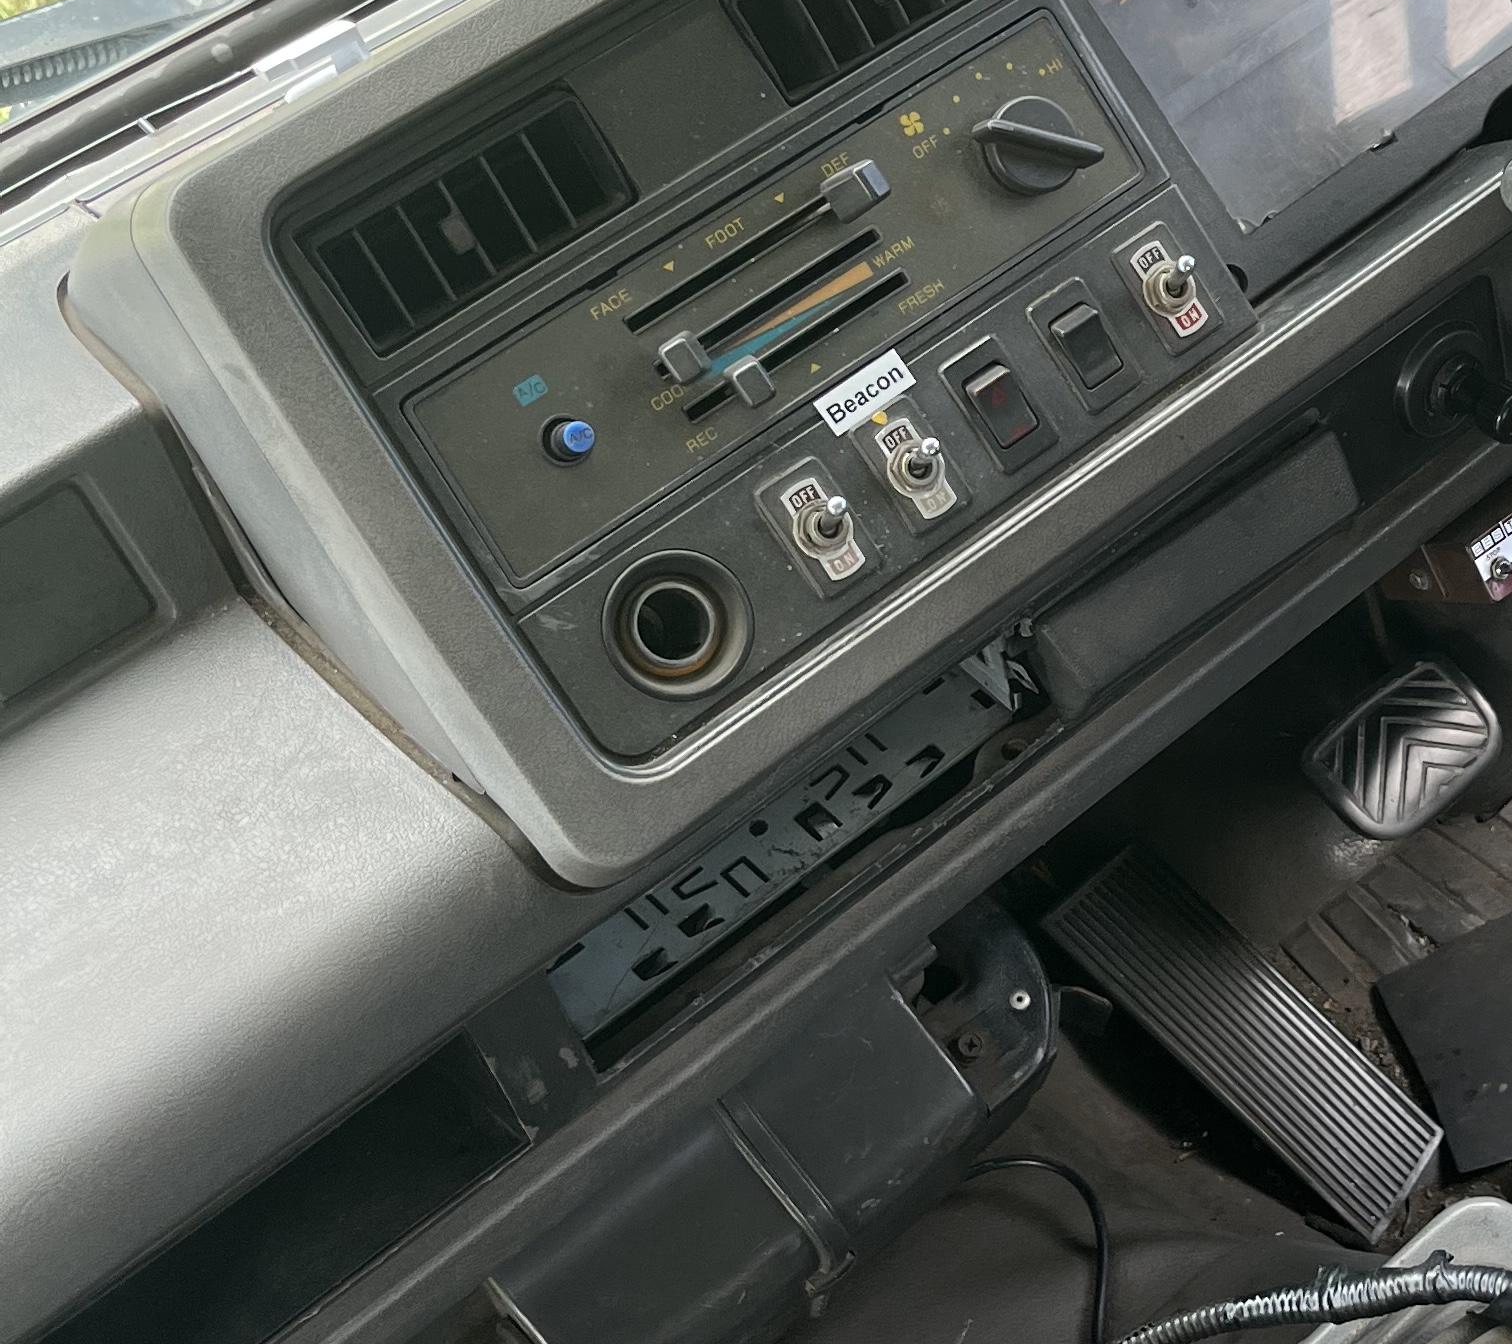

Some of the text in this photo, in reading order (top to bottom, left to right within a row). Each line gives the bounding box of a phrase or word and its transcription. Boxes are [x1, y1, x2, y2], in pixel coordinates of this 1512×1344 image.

[911, 134, 940, 160] OFF
[820, 151, 851, 179] DEF
[704, 216, 747, 249] FOOT
[871, 235, 917, 269] WARM
[1137, 247, 1163, 271] OFF
[589, 288, 633, 321] FACE
[897, 278, 946, 315] FRESH
[1179, 304, 1202, 329] ON
[516, 380, 547, 399] A/C
[650, 383, 688, 411] COO
[825, 365, 905, 425] Beacon
[568, 426, 594, 445] A/C
[685, 427, 719, 453] REC
[884, 426, 911, 448] OFF
[791, 486, 819, 509] OFF
[927, 489, 949, 511] ON
[835, 549, 859, 573] ON
